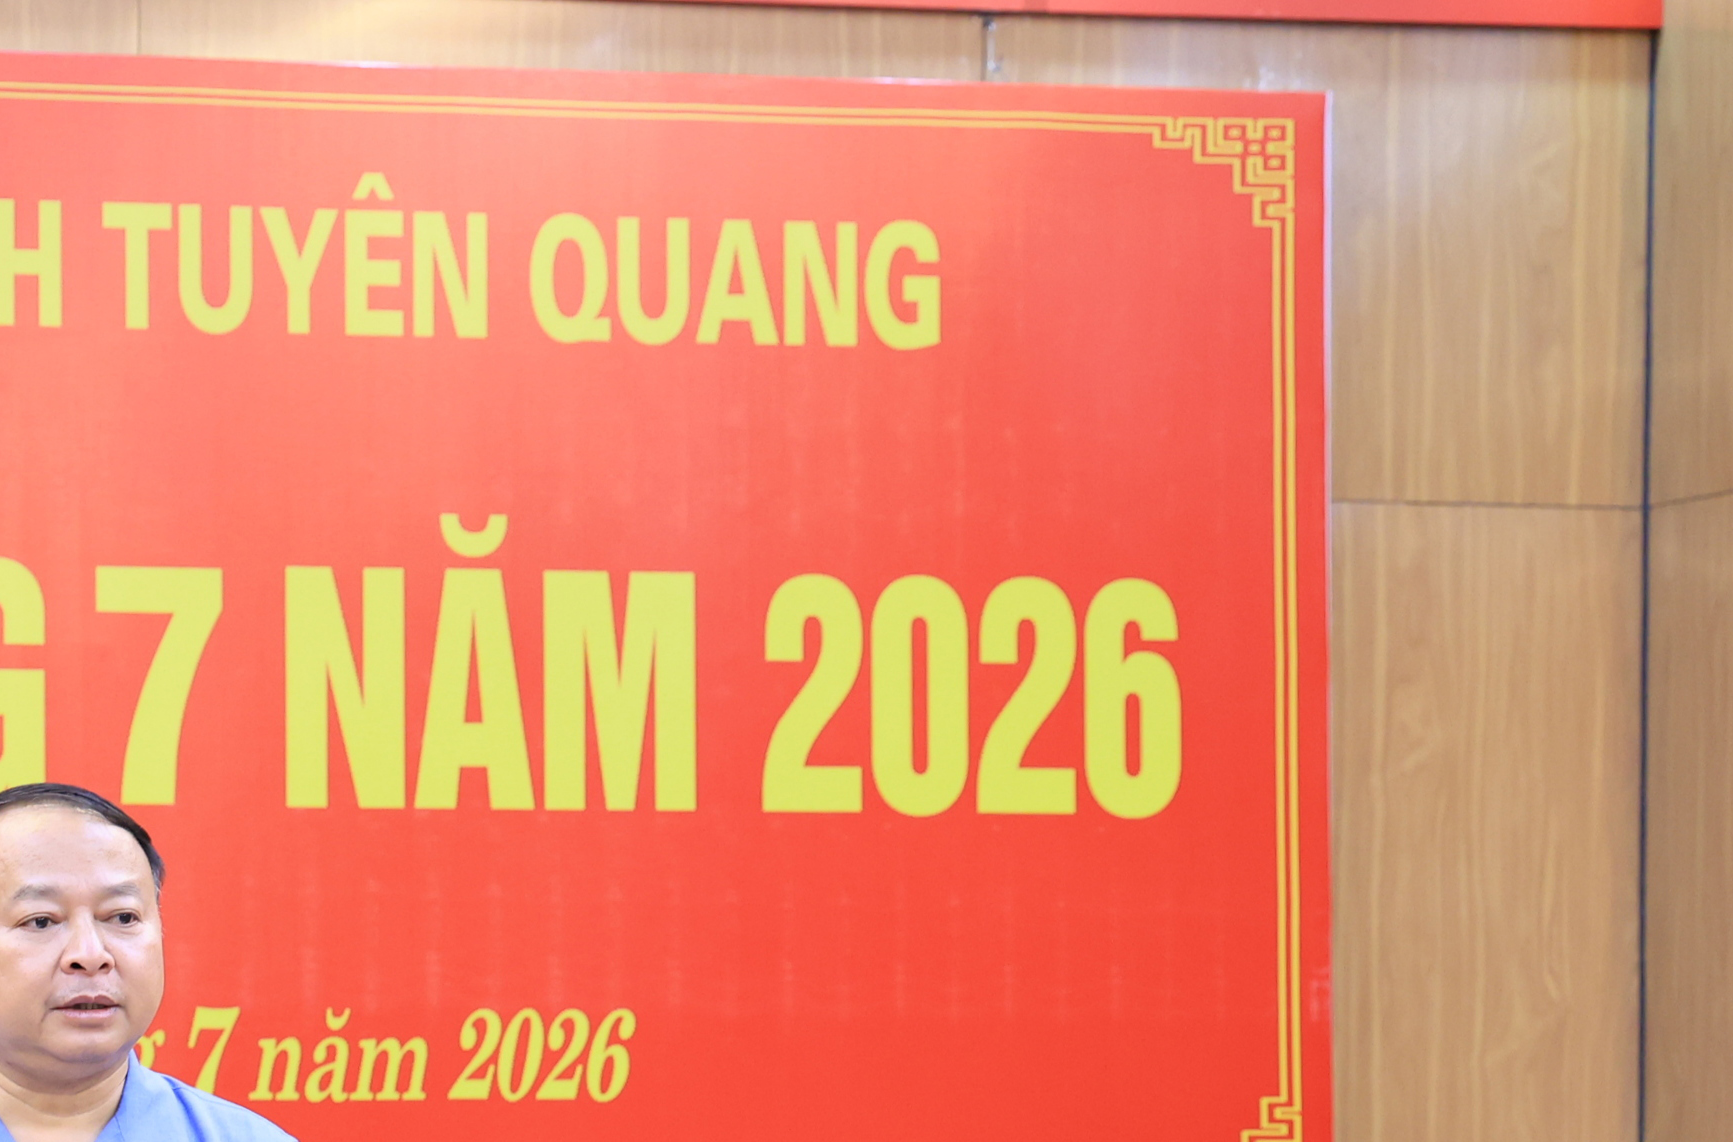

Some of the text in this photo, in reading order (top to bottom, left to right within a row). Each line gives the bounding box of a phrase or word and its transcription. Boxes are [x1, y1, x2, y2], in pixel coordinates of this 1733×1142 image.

[104, 173, 487, 339] TUYÊN
[531, 213, 941, 351] QUANG
[96, 565, 224, 806] 7
[285, 513, 697, 812] NĂM
[762, 573, 1182, 819] 2026
[188, 1006, 241, 1094] 7
[249, 1008, 428, 1103] năm
[448, 1007, 636, 1103] 2026
